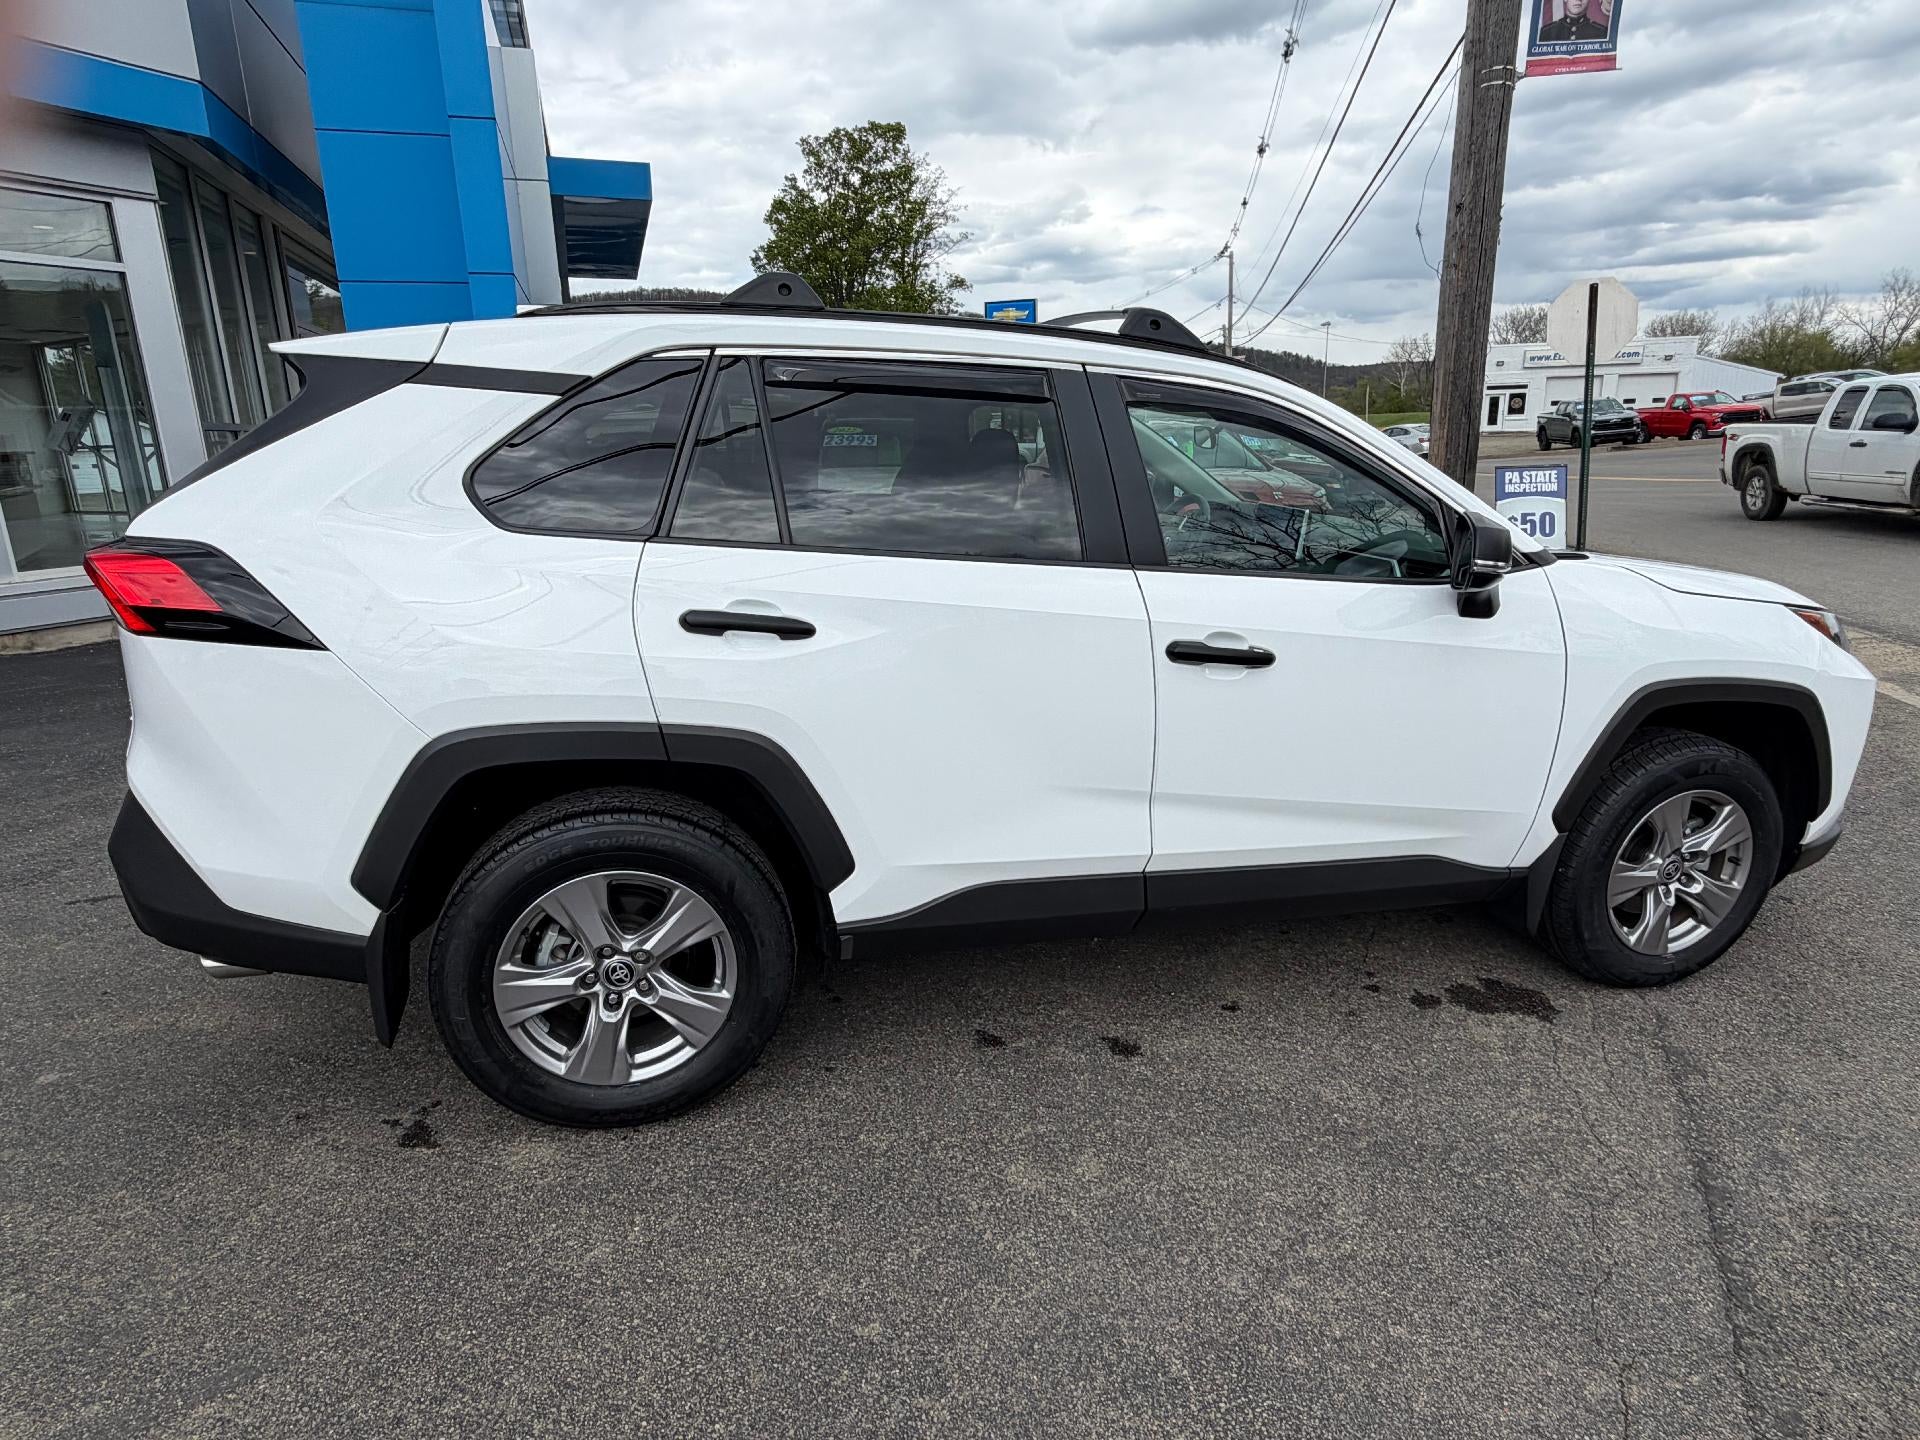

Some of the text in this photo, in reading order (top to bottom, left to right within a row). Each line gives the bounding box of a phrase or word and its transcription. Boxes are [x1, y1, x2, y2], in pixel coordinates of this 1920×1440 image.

[825, 435, 875, 445] 23995
[1504, 470, 1558, 483] PA STATE
[1504, 482, 1558, 493] INSPECTION
